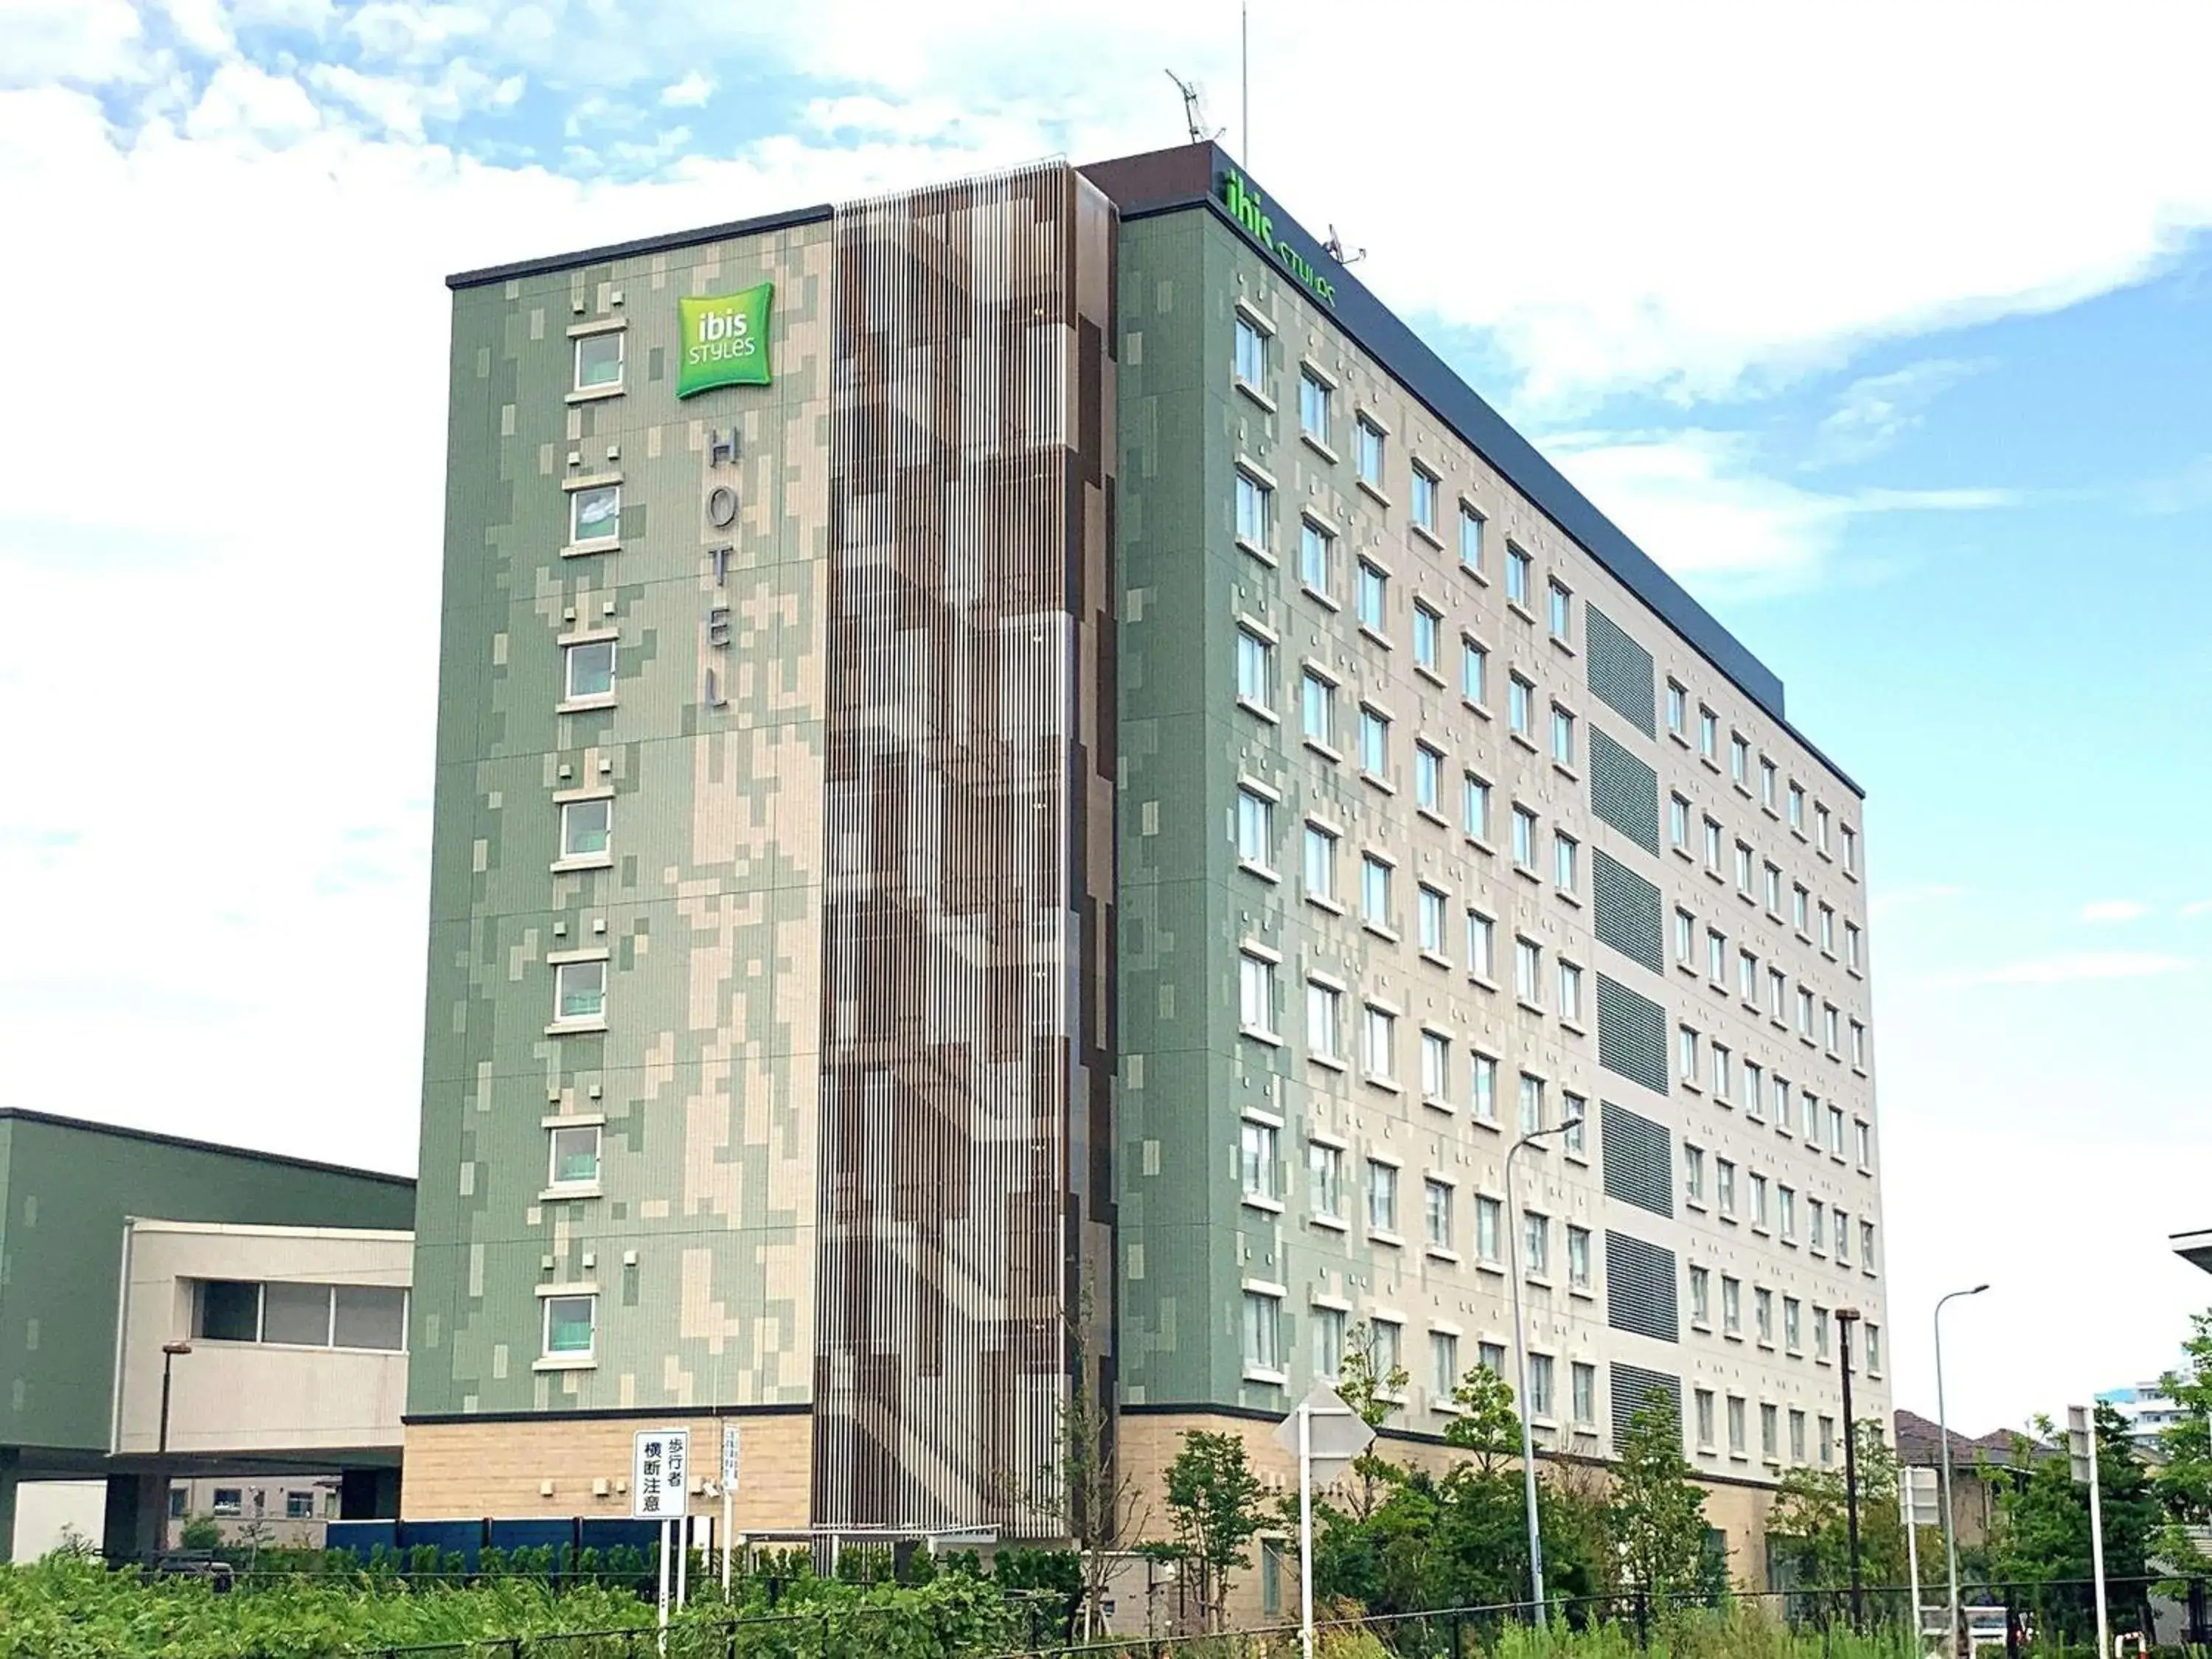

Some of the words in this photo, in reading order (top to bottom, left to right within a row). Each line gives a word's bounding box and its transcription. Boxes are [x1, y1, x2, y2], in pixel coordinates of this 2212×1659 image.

[698, 307, 748, 342] ibis
[706, 425, 737, 709] HOTEL
[642, 1441, 662, 1513] 横断注意
[668, 1437, 684, 1488] 歩行者
